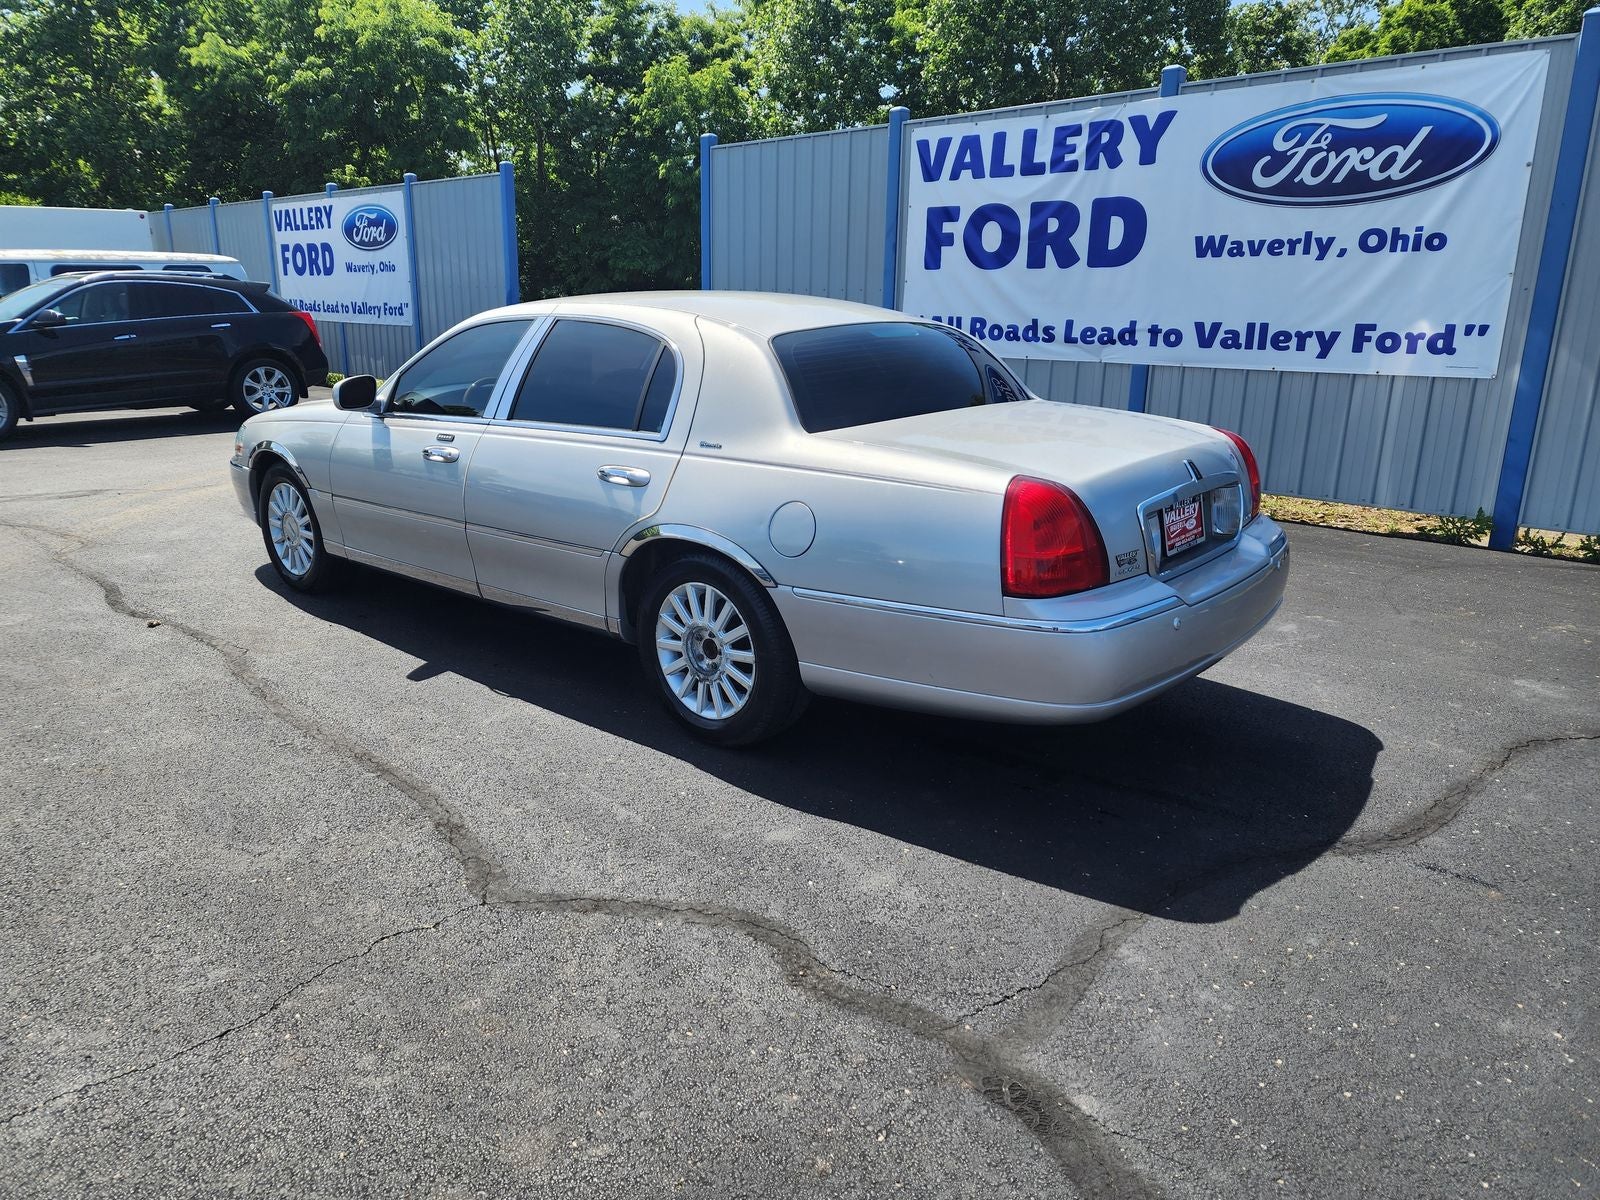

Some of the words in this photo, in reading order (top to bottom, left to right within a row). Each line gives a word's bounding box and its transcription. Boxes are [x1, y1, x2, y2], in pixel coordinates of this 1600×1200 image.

[916, 110, 1178, 182] VALLERY
[1251, 113, 1434, 189] Ford
[274, 205, 333, 232] VALLERY
[352, 212, 386, 242] Ford
[924, 196, 1147, 270] FORD
[280, 242, 334, 276] FORD
[1194, 231, 1348, 261] Waverly,
[1358, 226, 1448, 253] Ohio
[345, 261, 378, 275] Waverly,
[379, 261, 396, 273] Ohio
[299, 300, 321, 312] Roads
[322, 300, 340, 313] Lead
[341, 303, 350, 313] to
[351, 301, 381, 318] Vallery
[969, 317, 1056, 344] Roads
[1063, 319, 1138, 346] Lead
[1148, 324, 1183, 348] to
[1194, 322, 1341, 359] Vallery
[1165, 501, 1200, 524] VALLERY
